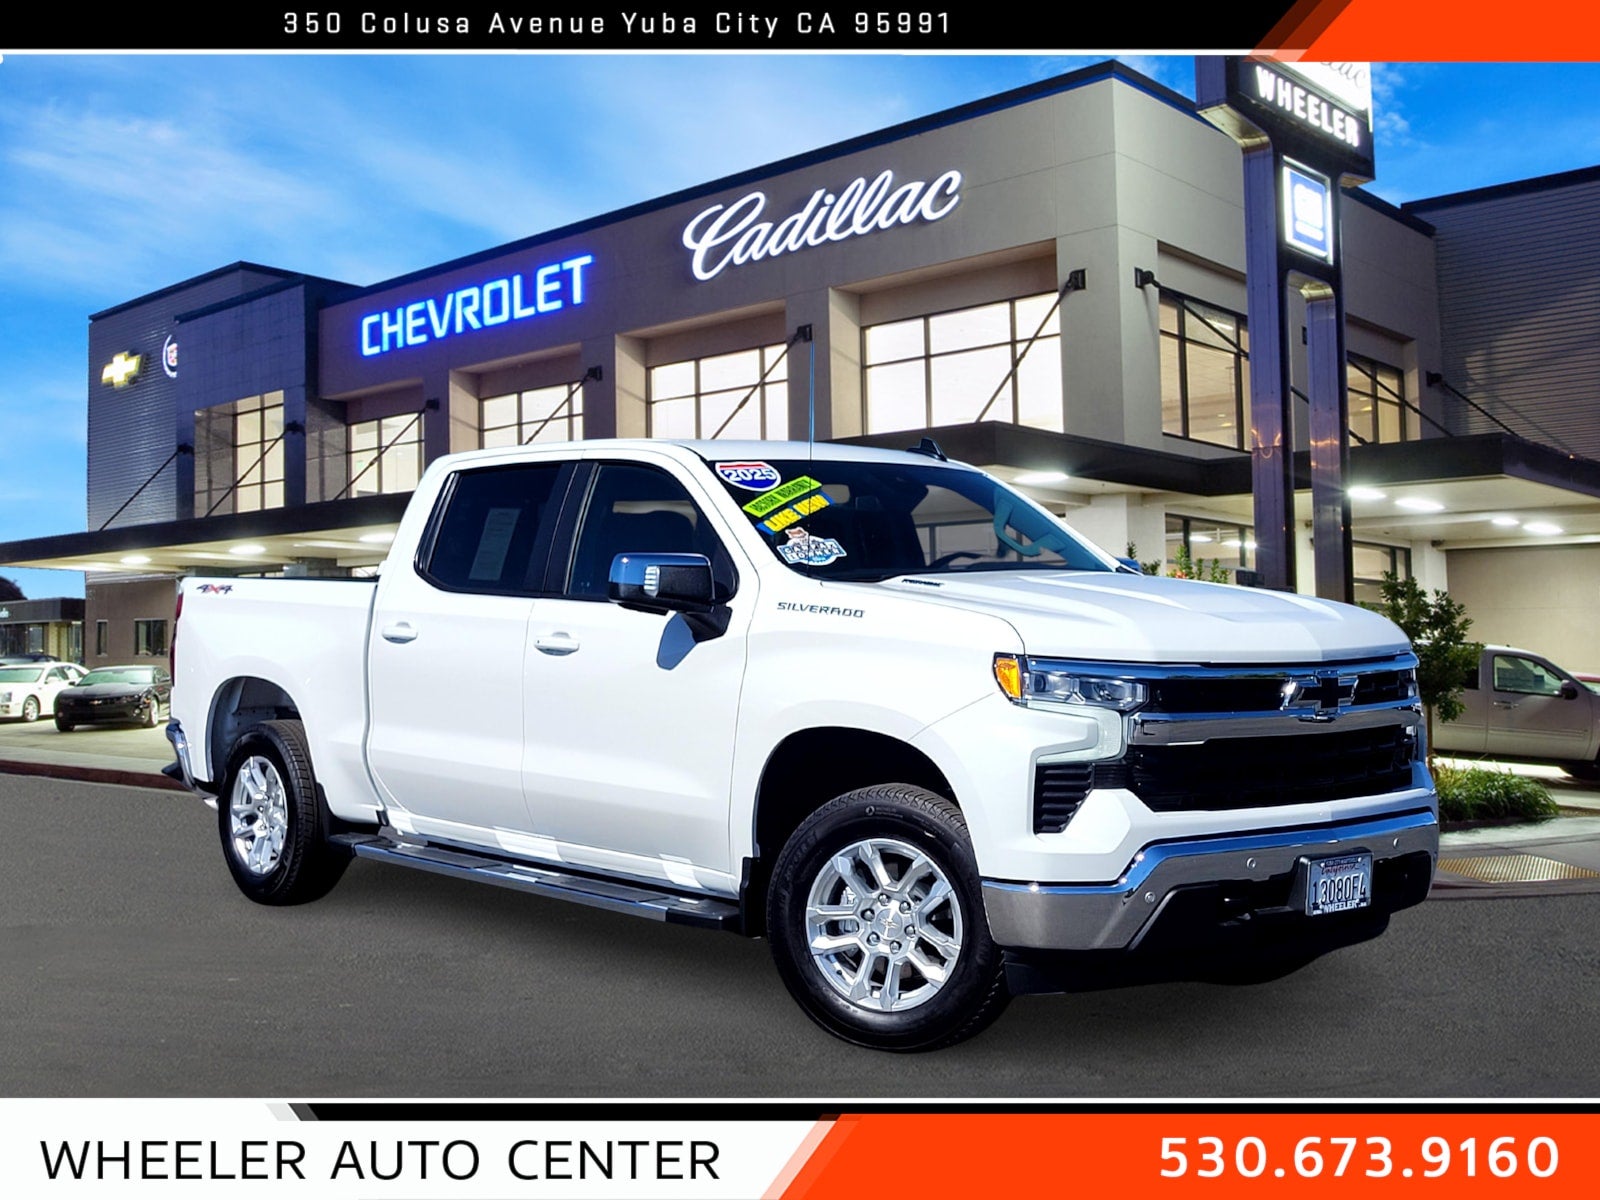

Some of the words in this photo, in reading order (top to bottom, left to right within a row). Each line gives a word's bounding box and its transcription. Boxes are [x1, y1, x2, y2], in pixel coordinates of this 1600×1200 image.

[1255, 64, 1360, 147] WHEELER
[682, 169, 963, 281] Cadillac
[360, 254, 594, 358] CHEVROLET
[724, 468, 777, 481] 2025
[777, 602, 865, 618] SILVERADO
[1323, 900, 1358, 914] WHEELER
